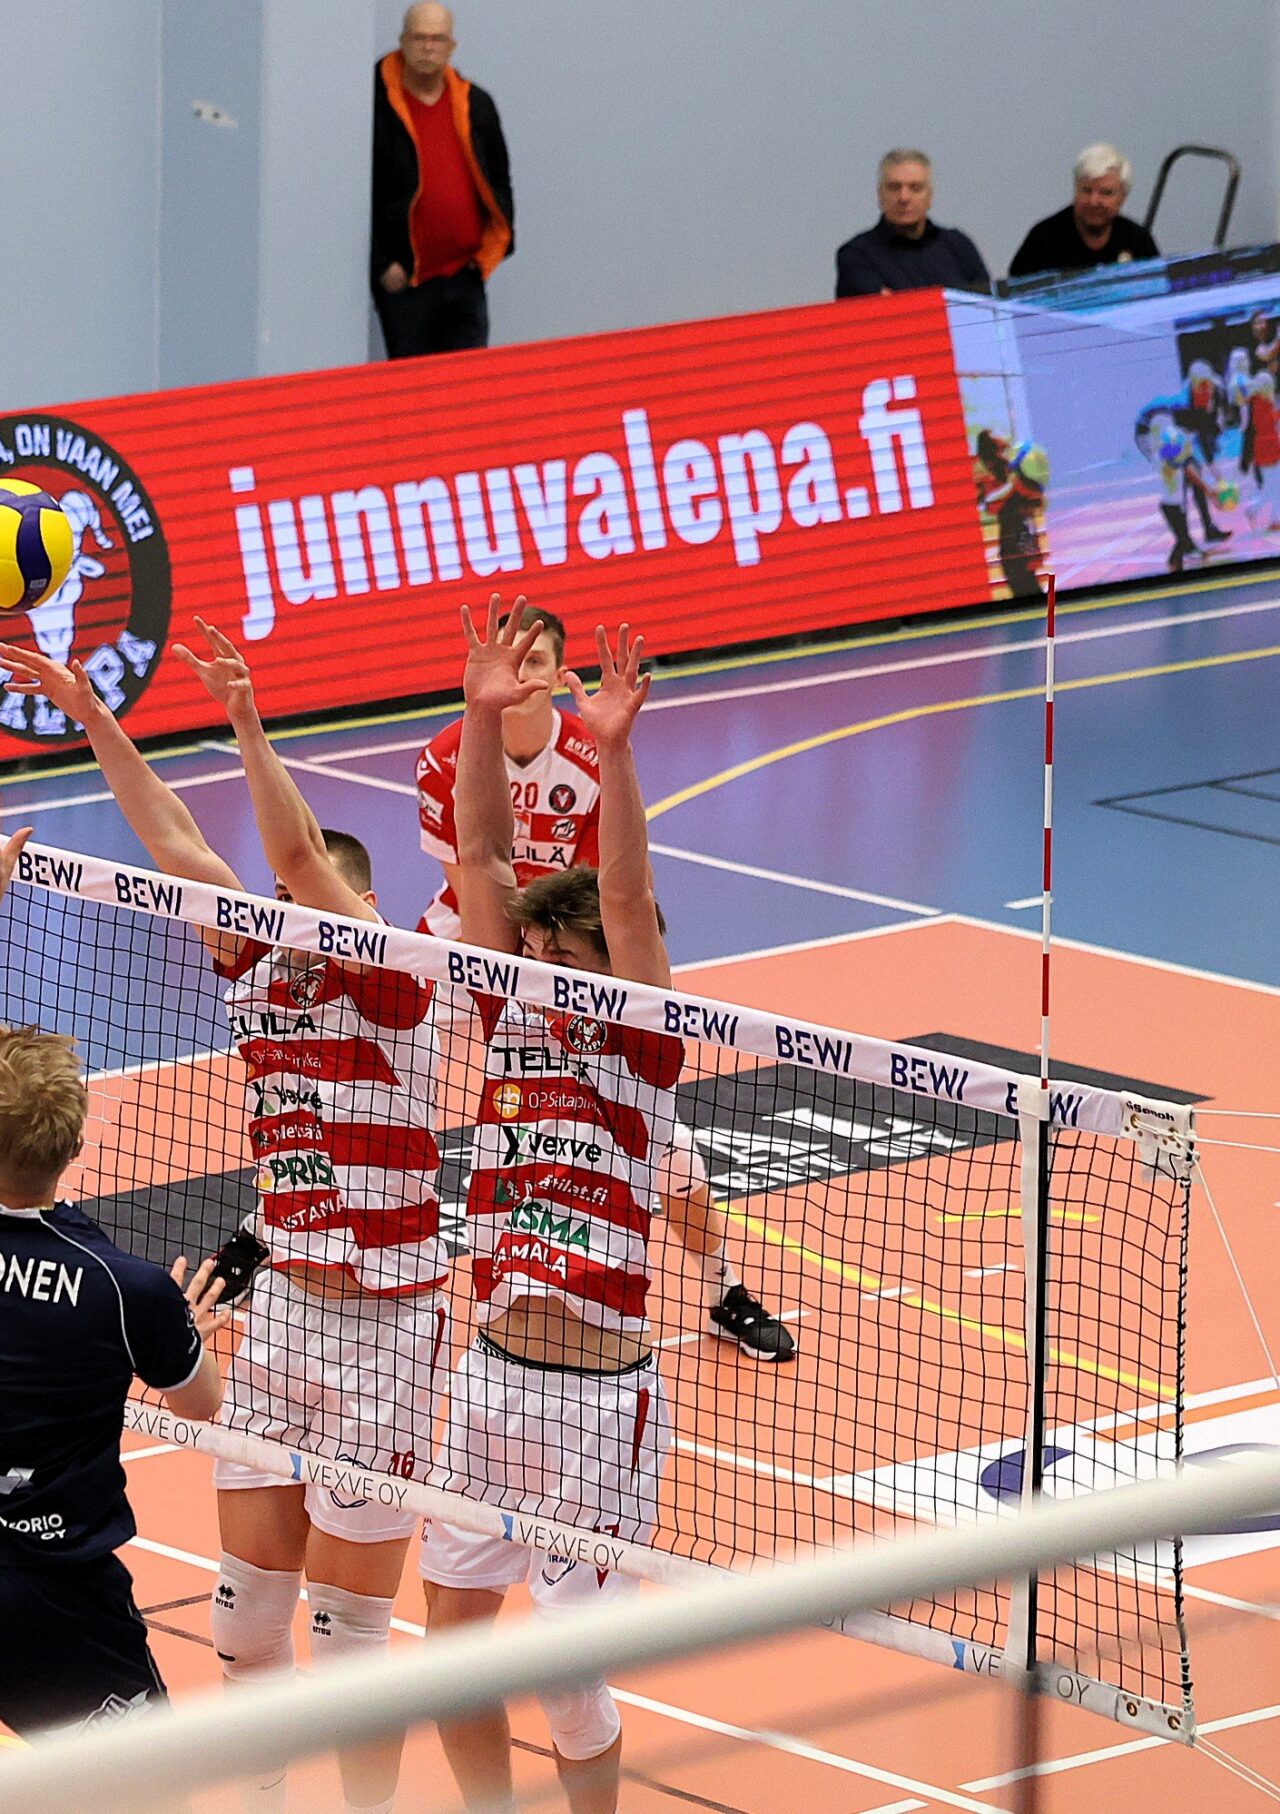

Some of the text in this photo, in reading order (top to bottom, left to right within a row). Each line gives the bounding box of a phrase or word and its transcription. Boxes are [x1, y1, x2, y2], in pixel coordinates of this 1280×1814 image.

[14, 424, 51, 457] ON
[56, 428, 119, 492] VAAN
[228, 375, 935, 641] junnuvalepa.fi
[510, 781, 540, 810] 20
[19, 850, 83, 893] BEWI
[512, 845, 569, 869] LILÄ
[115, 871, 183, 917] BEWI
[217, 897, 286, 942] BEWI
[319, 921, 388, 965] BEWI
[449, 951, 520, 998] BEWI
[554, 975, 627, 1021] BEWI
[664, 1001, 740, 1046] BEWI
[776, 1025, 853, 1074] BEWI
[891, 1053, 970, 1102] BEWI
[528, 1133, 602, 1163] vexve
[122, 1404, 203, 1448] EXVE OY
[307, 1460, 408, 1509] VEXVE OY
[391, 1450, 415, 1480] 16
[520, 1521, 588, 1563] VEXVE
[593, 1543, 624, 1570] OY
[1056, 1674, 1090, 1705] OY
